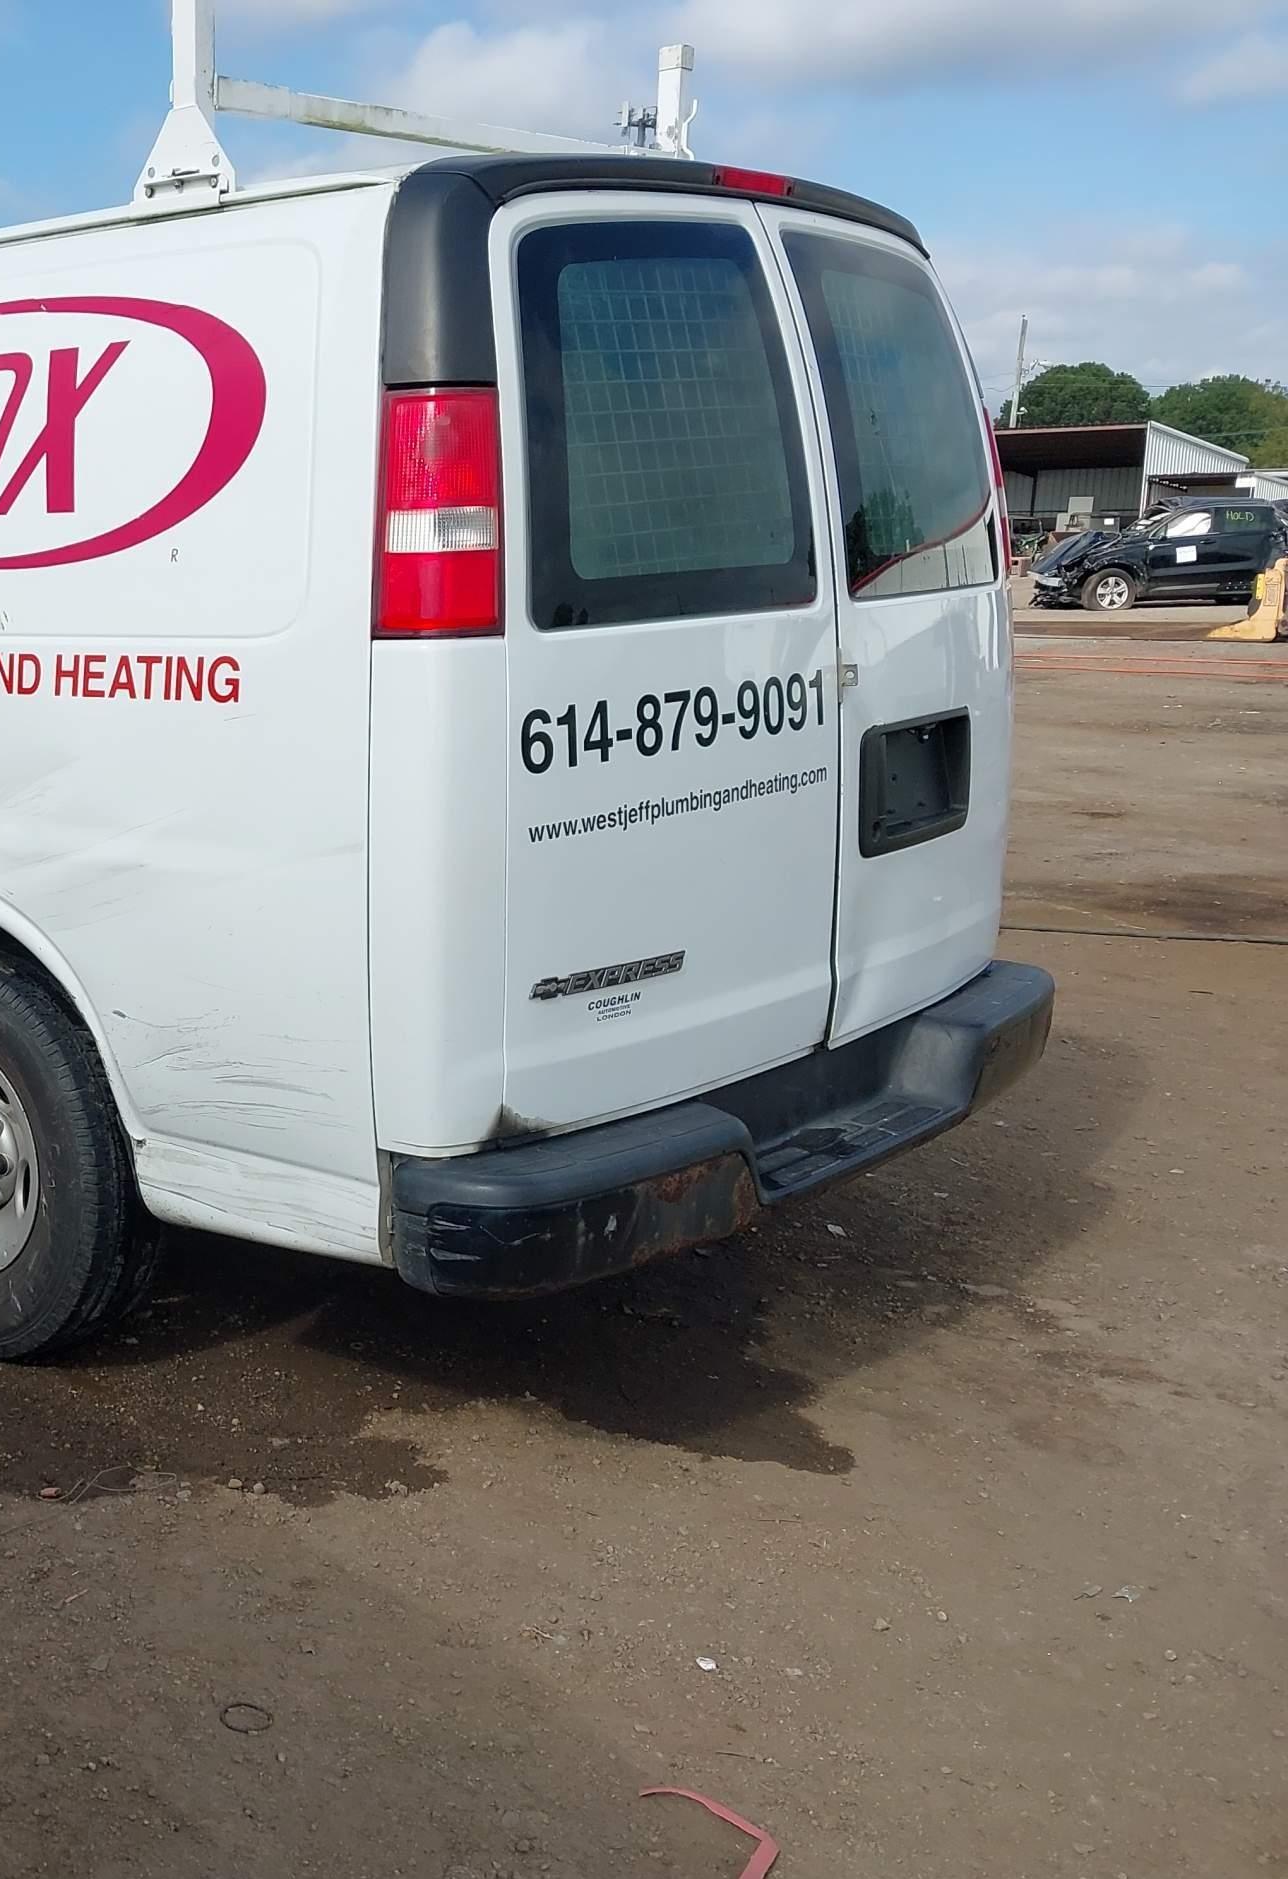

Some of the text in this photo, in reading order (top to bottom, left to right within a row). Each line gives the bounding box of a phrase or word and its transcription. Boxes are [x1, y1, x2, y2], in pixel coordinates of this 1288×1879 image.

[1226, 510, 1255, 521] HOLD
[54, 654, 241, 703] HEATING
[520, 669, 824, 774] 614-879-9091
[528, 766, 828, 843] www.westjeffplumbingandheating.com
[565, 954, 684, 995] EXPRESS
[587, 991, 641, 1011] COUGHLIN
[596, 1009, 632, 1022] LONDON
